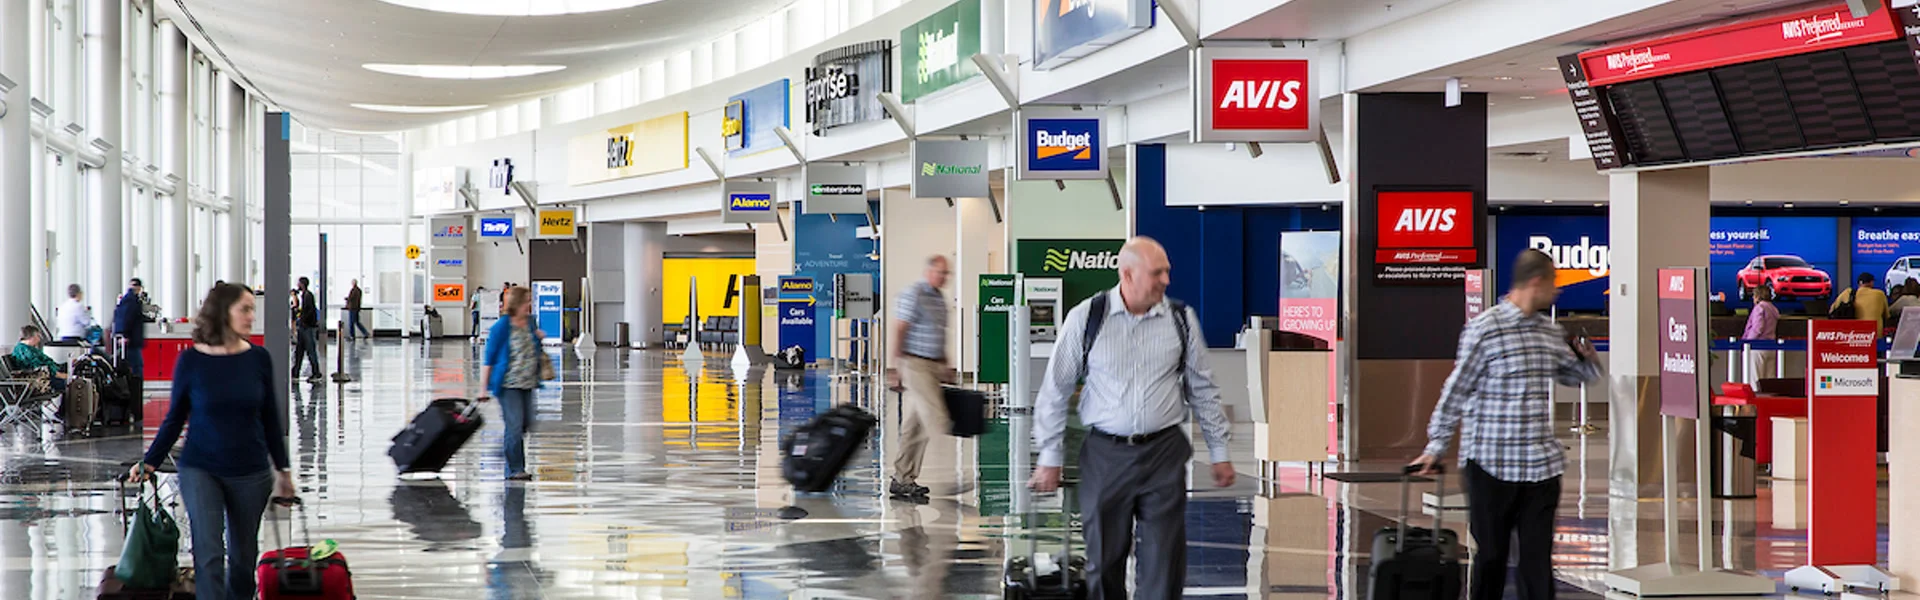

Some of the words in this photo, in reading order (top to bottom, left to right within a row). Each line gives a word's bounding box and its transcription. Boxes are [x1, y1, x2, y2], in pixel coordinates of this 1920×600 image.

[1781, 19, 1801, 39] AVIS
[1220, 80, 1301, 109] AVIS
[1037, 130, 1091, 150] Budget
[936, 164, 982, 175] National
[814, 185, 862, 195] enterprise
[731, 197, 770, 208] Alamo
[542, 218, 571, 227] Hertz
[1393, 208, 1457, 231] AVIS
[1727, 229, 1770, 242] yourself.
[1858, 229, 1900, 241] Breathe
[1069, 251, 1119, 269] Natio
[1528, 235, 1609, 277] Budg
[782, 281, 813, 290] Alamo
[1669, 275, 1685, 292] AVIS
[789, 307, 805, 316] Cars
[1312, 306, 1324, 318] TO
[1283, 319, 1324, 331] GROWING
[1668, 317, 1688, 342] Cars
[1816, 331, 1835, 341] AVIS
[1664, 352, 1695, 374] Available
[1821, 352, 1870, 363] Welcomes
[1834, 377, 1873, 388] Microsoft
